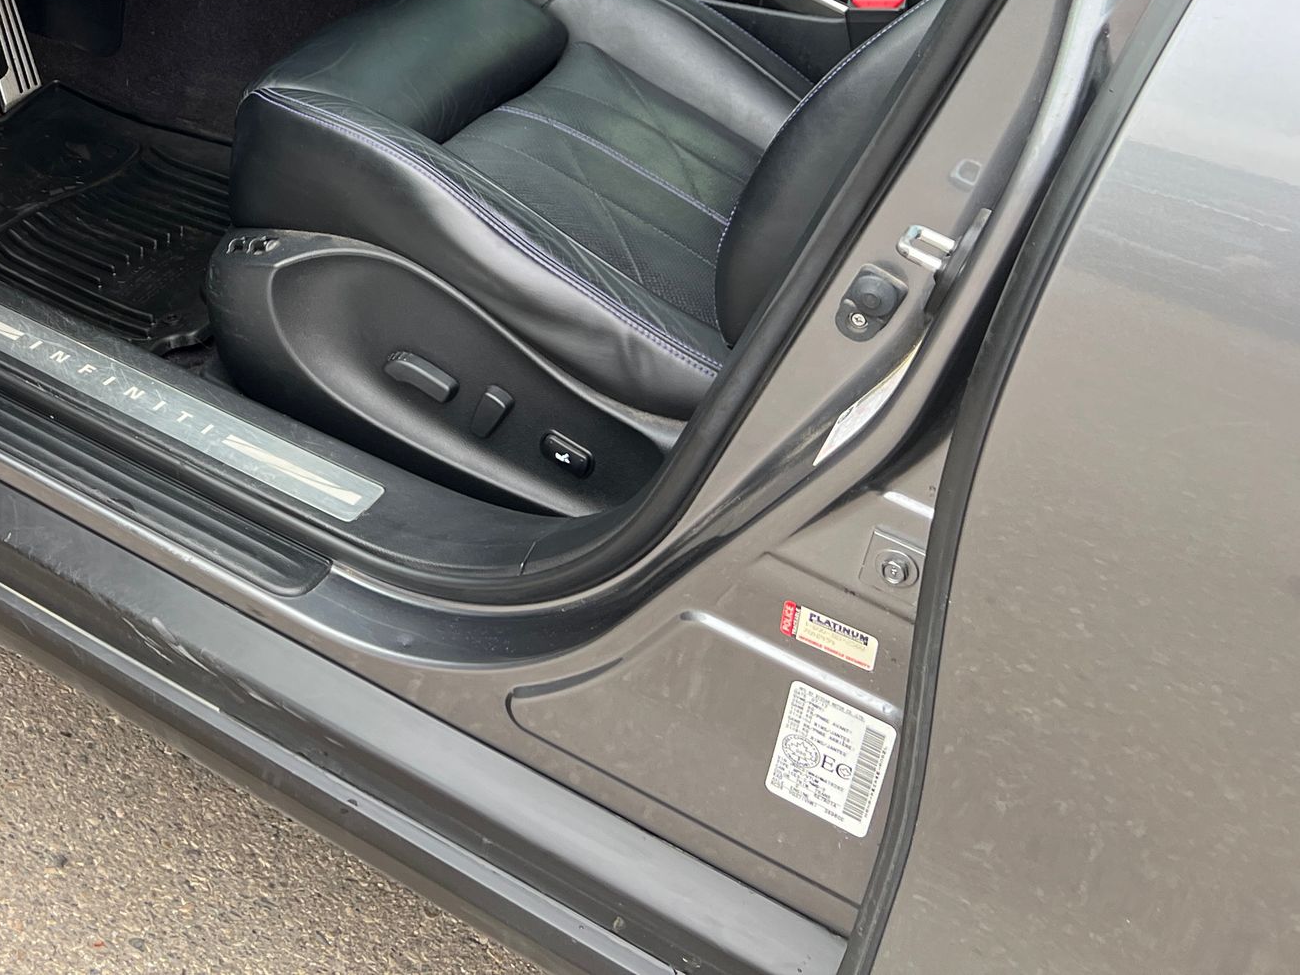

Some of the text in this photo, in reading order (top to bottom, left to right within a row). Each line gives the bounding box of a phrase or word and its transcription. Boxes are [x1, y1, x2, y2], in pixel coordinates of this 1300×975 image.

[29, 340, 214, 436] INFINITI
[782, 604, 795, 633] POLICE
[808, 613, 869, 647] PLATINUM
